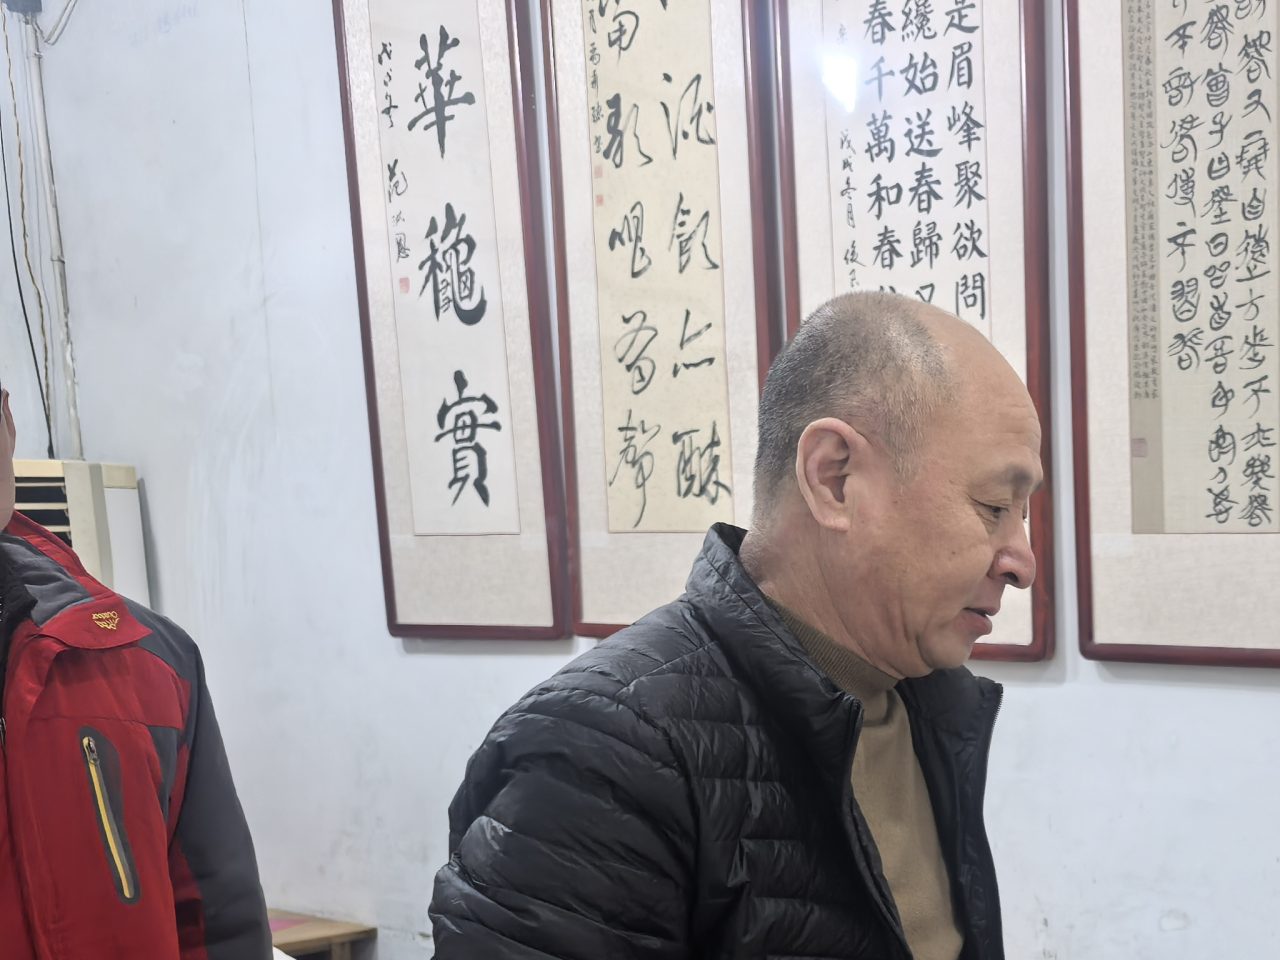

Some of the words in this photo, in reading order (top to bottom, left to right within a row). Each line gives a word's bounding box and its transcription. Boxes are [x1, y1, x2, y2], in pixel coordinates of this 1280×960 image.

[863, 0, 904, 294] 春千萬和春
